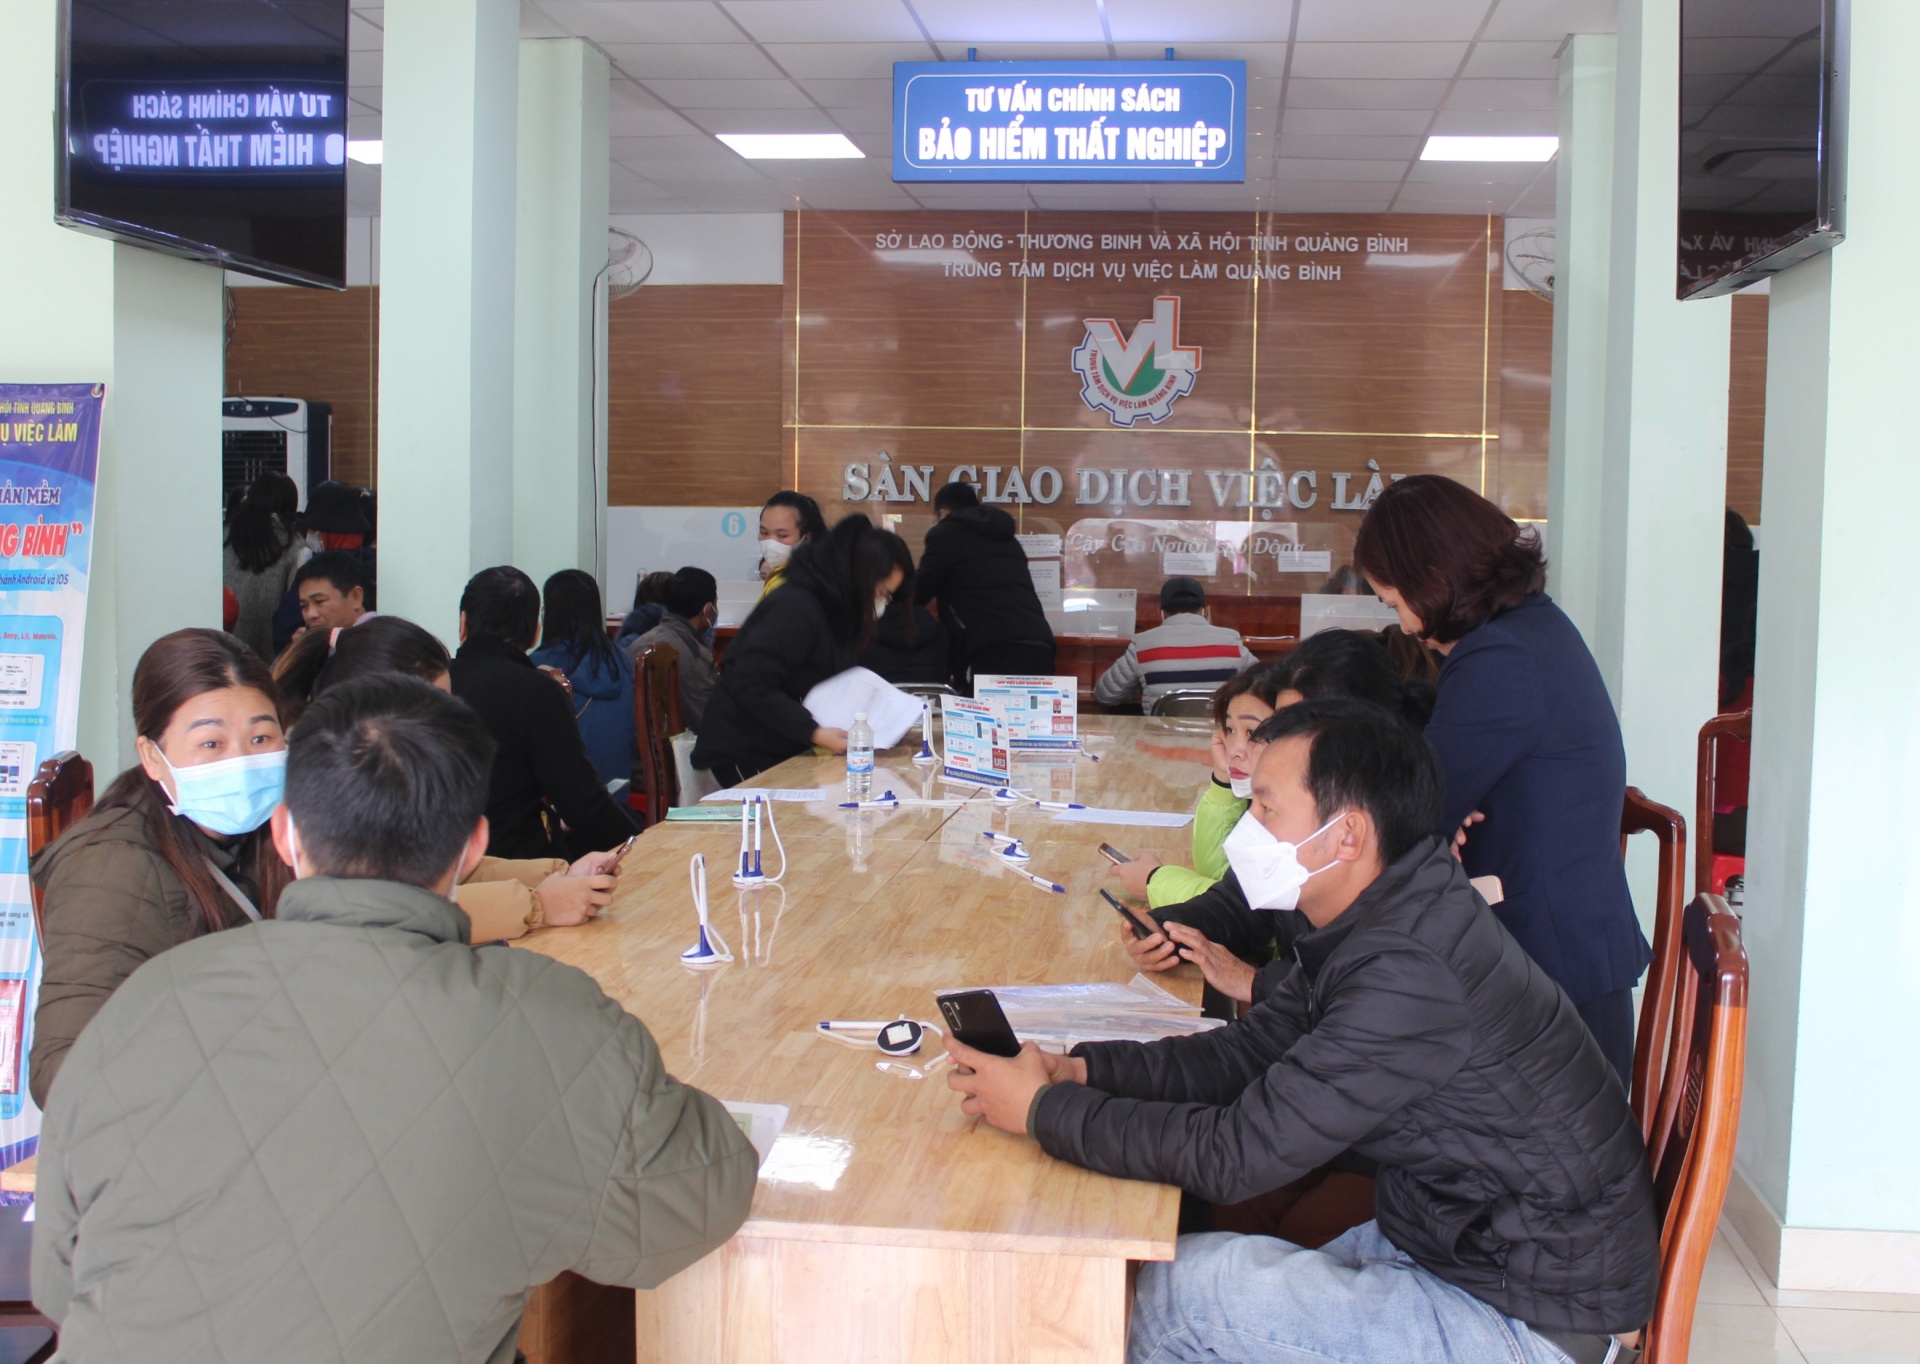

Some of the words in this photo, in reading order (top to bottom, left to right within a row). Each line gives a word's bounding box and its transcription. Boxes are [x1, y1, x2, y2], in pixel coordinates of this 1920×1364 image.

[965, 86, 995, 112] TƯ
[998, 80, 1042, 112] VẤN
[1047, 83, 1115, 112] CHÍNH
[1121, 83, 1181, 112] SÁCH
[919, 117, 972, 161] BẢO
[979, 114, 1047, 161] HIỂM
[1053, 116, 1120, 161] THẤT
[1127, 120, 1226, 168] NGHIỆP
[875, 229, 902, 249] SỞ
[908, 234, 945, 249] LAO
[952, 230, 1003, 253] ĐỘNG
[1016, 234, 1093, 250] THƯƠNG
[1101, 234, 1142, 250] BINH
[1149, 230, 1171, 250] VÀ
[1177, 231, 1202, 250] XÃ
[1209, 231, 1240, 255] HỘI
[1248, 231, 1287, 251] TỈNH
[1295, 232, 1359, 252] QUẢNG
[1366, 232, 1408, 252] BÌNH
[942, 262, 1001, 277] TRUNG
[1009, 258, 1045, 278] TÂM
[1053, 262, 1094, 281] DỊCH
[1102, 263, 1126, 282] VỤ
[1133, 260, 1173, 282] VIỆC
[1180, 260, 1218, 279] LÀM
[1225, 262, 1291, 280] QUẢNG
[1298, 261, 1341, 280] BÌNH
[13, 419, 45, 446] VIỆC
[47, 418, 78, 442] LÀM
[843, 450, 934, 502] SÀN
[949, 465, 1063, 504] GIAO
[1075, 468, 1192, 516] DỊCH
[1204, 457, 1318, 520] VIỆC
[1330, 458, 1407, 510] LÀ
[728, 514, 740, 536] 6
[17, 573, 46, 585] Android
